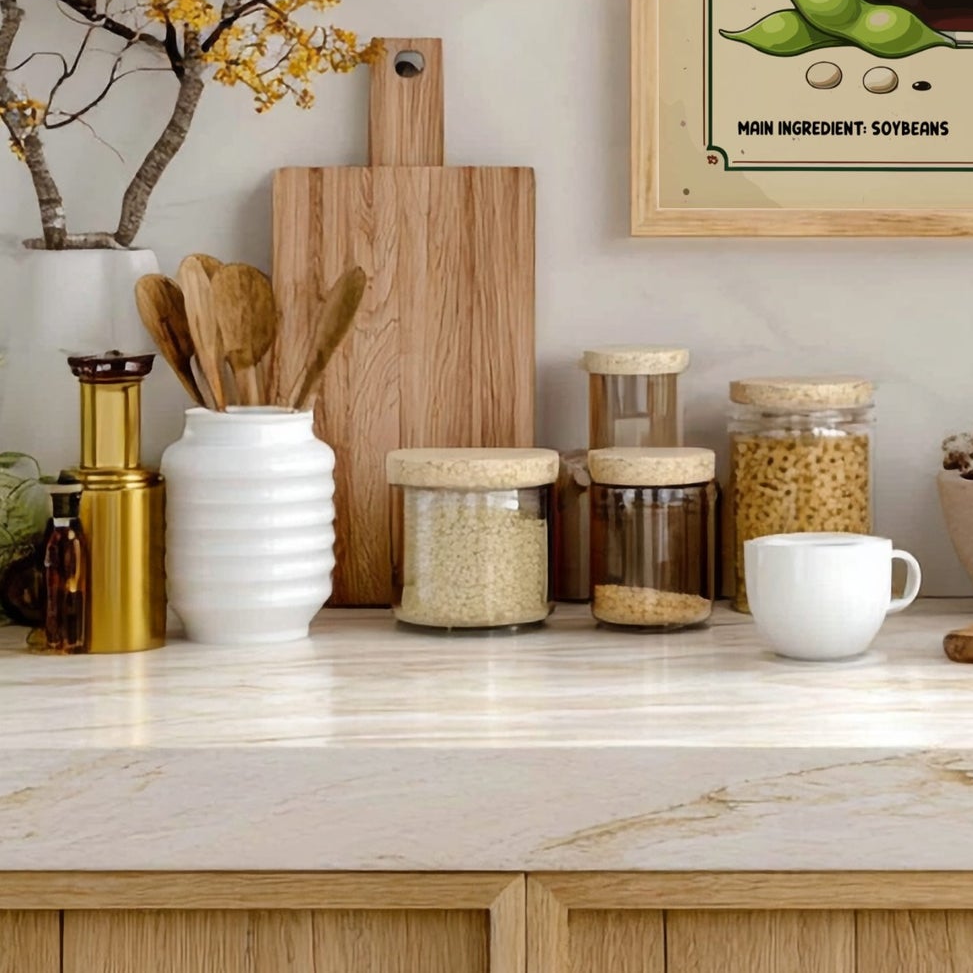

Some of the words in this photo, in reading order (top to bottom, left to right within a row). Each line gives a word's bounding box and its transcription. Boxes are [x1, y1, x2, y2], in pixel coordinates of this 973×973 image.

[737, 120, 774, 136] MAIN
[778, 120, 867, 136] INGREDIENT:
[871, 120, 949, 136] SOYBEANS
